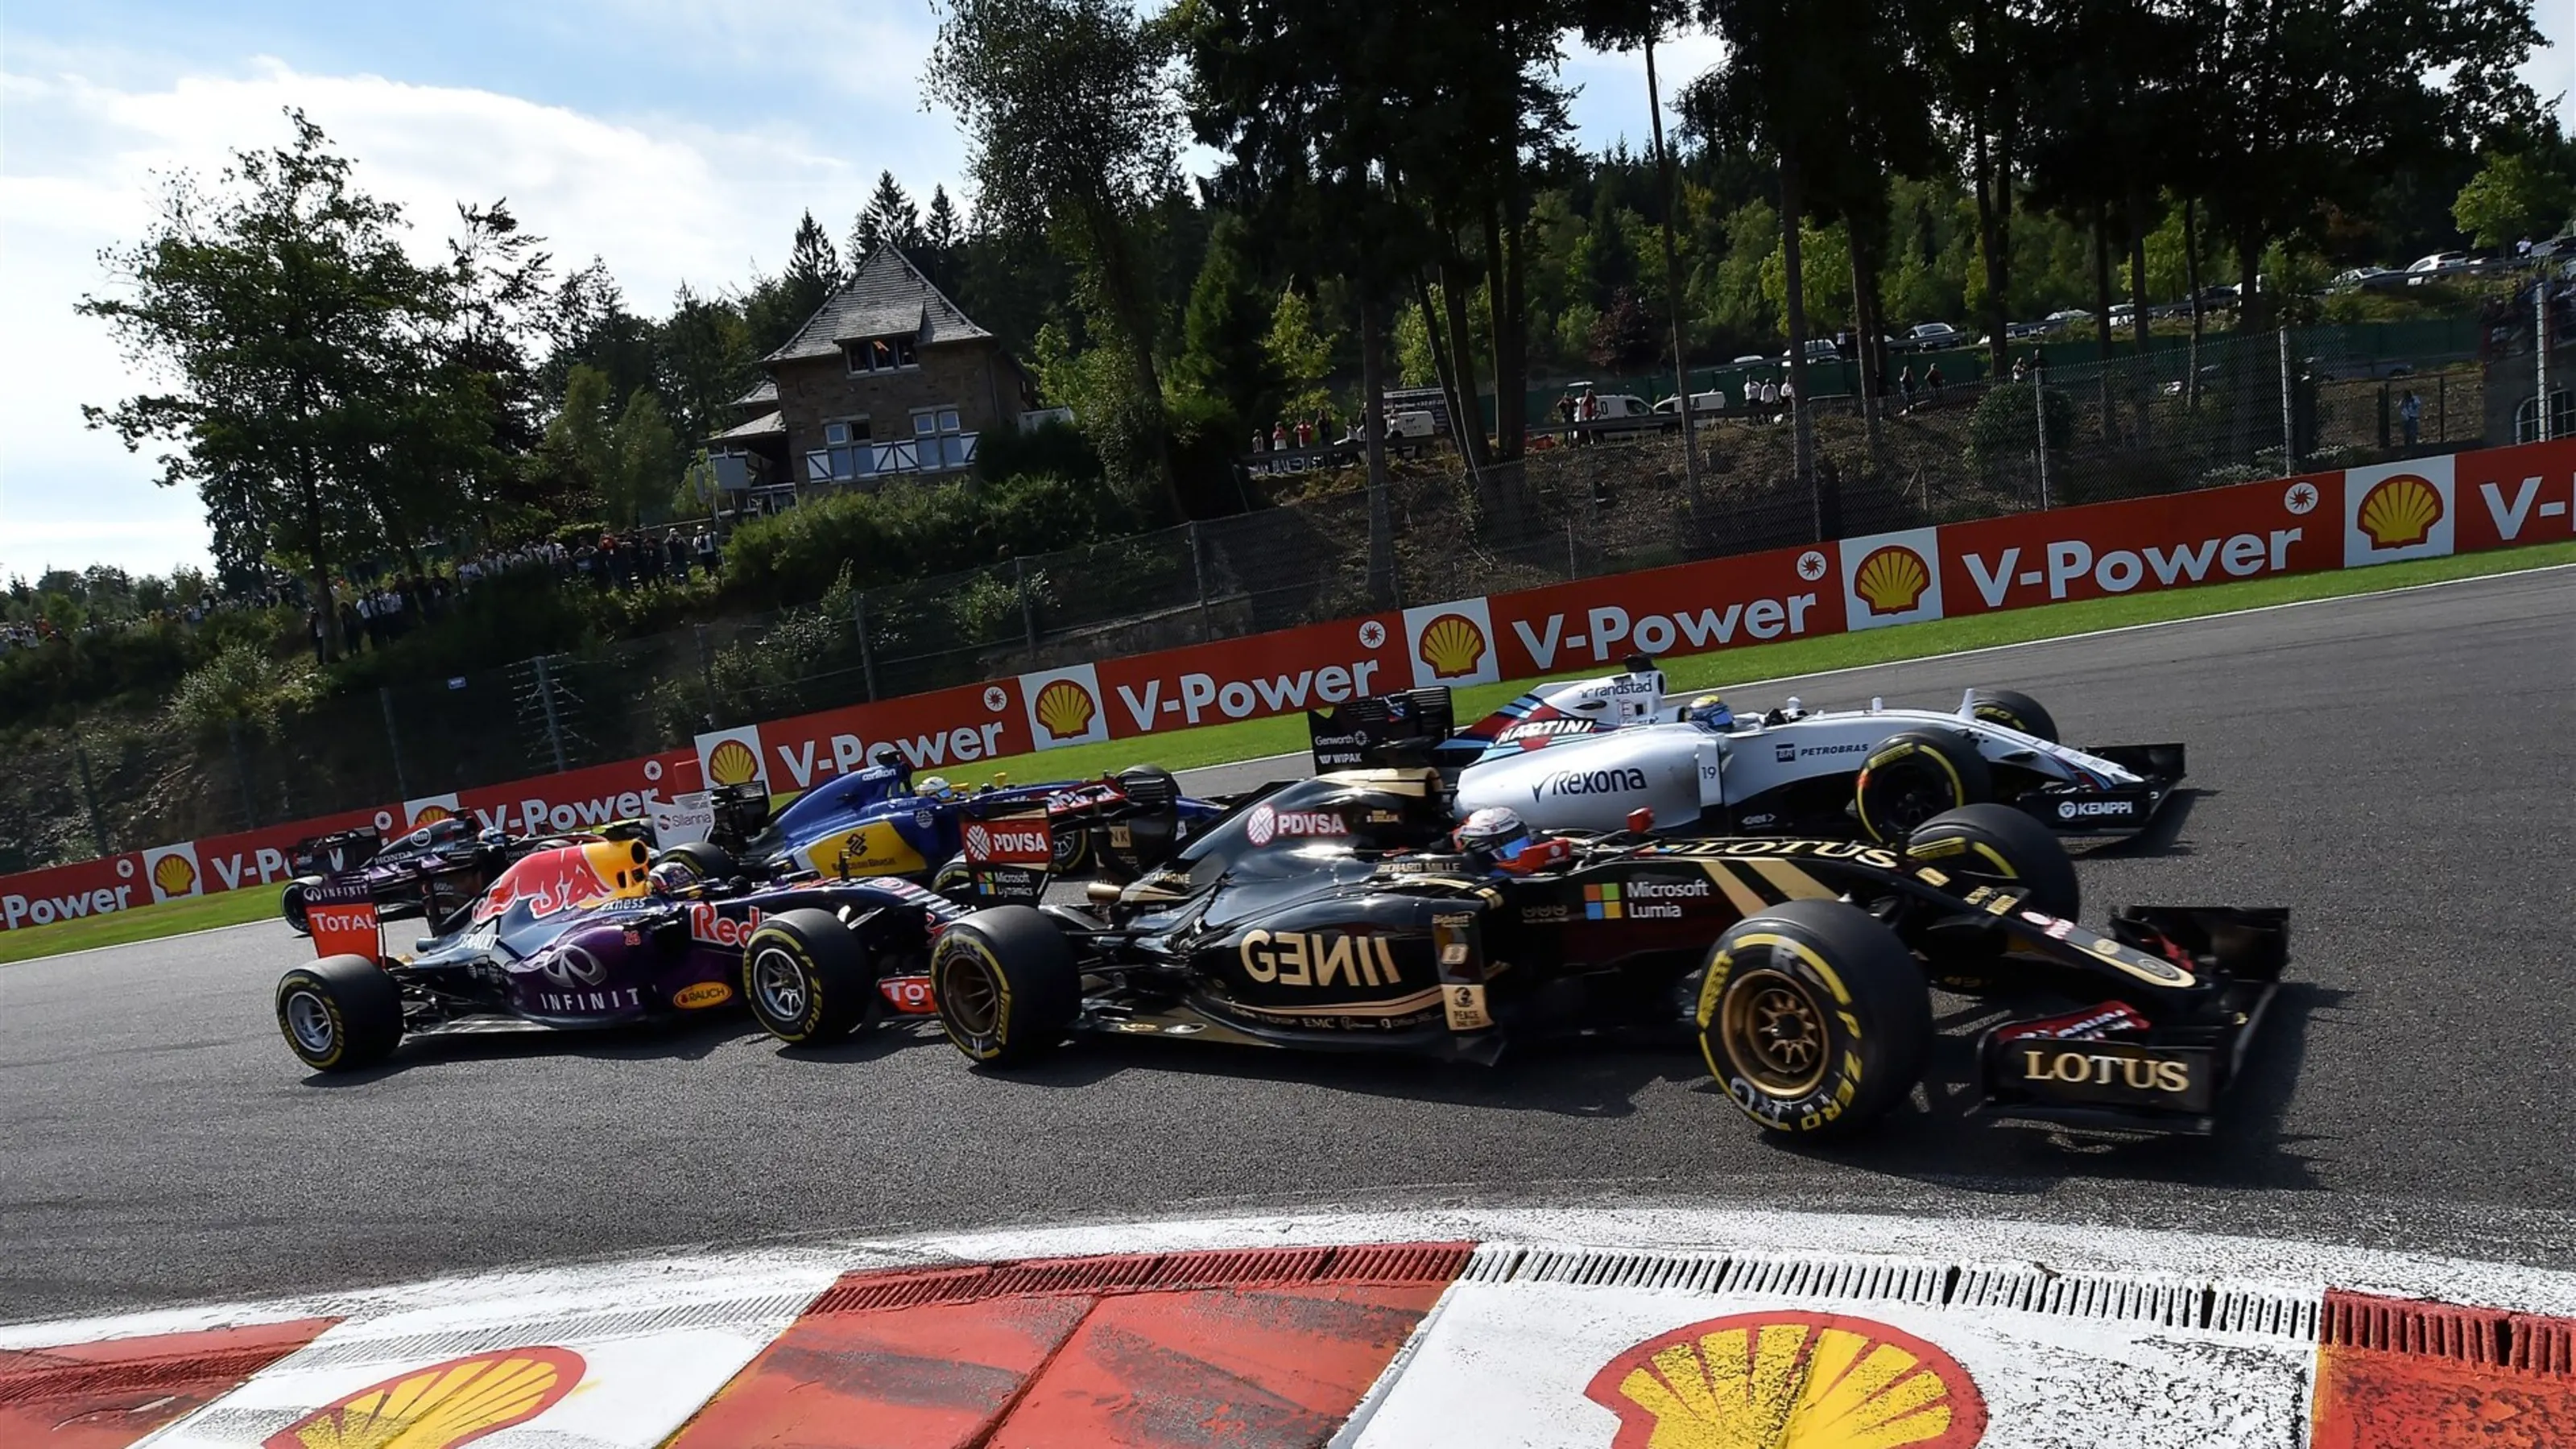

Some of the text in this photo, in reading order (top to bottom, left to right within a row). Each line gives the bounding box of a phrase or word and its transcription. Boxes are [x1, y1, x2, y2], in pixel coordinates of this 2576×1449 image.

[1962, 527, 2302, 607] V-Power
[1511, 592, 1817, 670] V-Power
[1116, 658, 1379, 732] V-Power
[1594, 674, 1652, 698] randstad
[1315, 734, 1354, 746] Genworth
[1495, 720, 1596, 745] MARTINI
[777, 721, 1004, 788] V-Power
[1333, 753, 1362, 764] WIPAK
[1800, 743, 1869, 757] PETROBRAS
[1552, 767, 1648, 795] Rexona
[1701, 766, 1718, 779] 19
[474, 787, 660, 835] V-Power
[2078, 801, 2133, 815] KEMPPI
[1278, 813, 1347, 834] PDVSA
[993, 832, 1048, 852] PDVSA
[374, 851, 413, 865] HONDA
[1682, 840, 1898, 869] LOTUS
[994, 871, 1031, 884] Microsoft
[997, 885, 1033, 898] Dynamics
[1626, 878, 1710, 898] Microsoft
[1628, 902, 1682, 919] Lumia
[310, 912, 377, 932] TOTAL
[690, 902, 760, 948] Red
[688, 987, 725, 1001] RAUCH
[1301, 1017, 1337, 1029] EMC
[2023, 1050, 2190, 1092] LOTUS
[1801, 1049, 1863, 1132] ZERO
